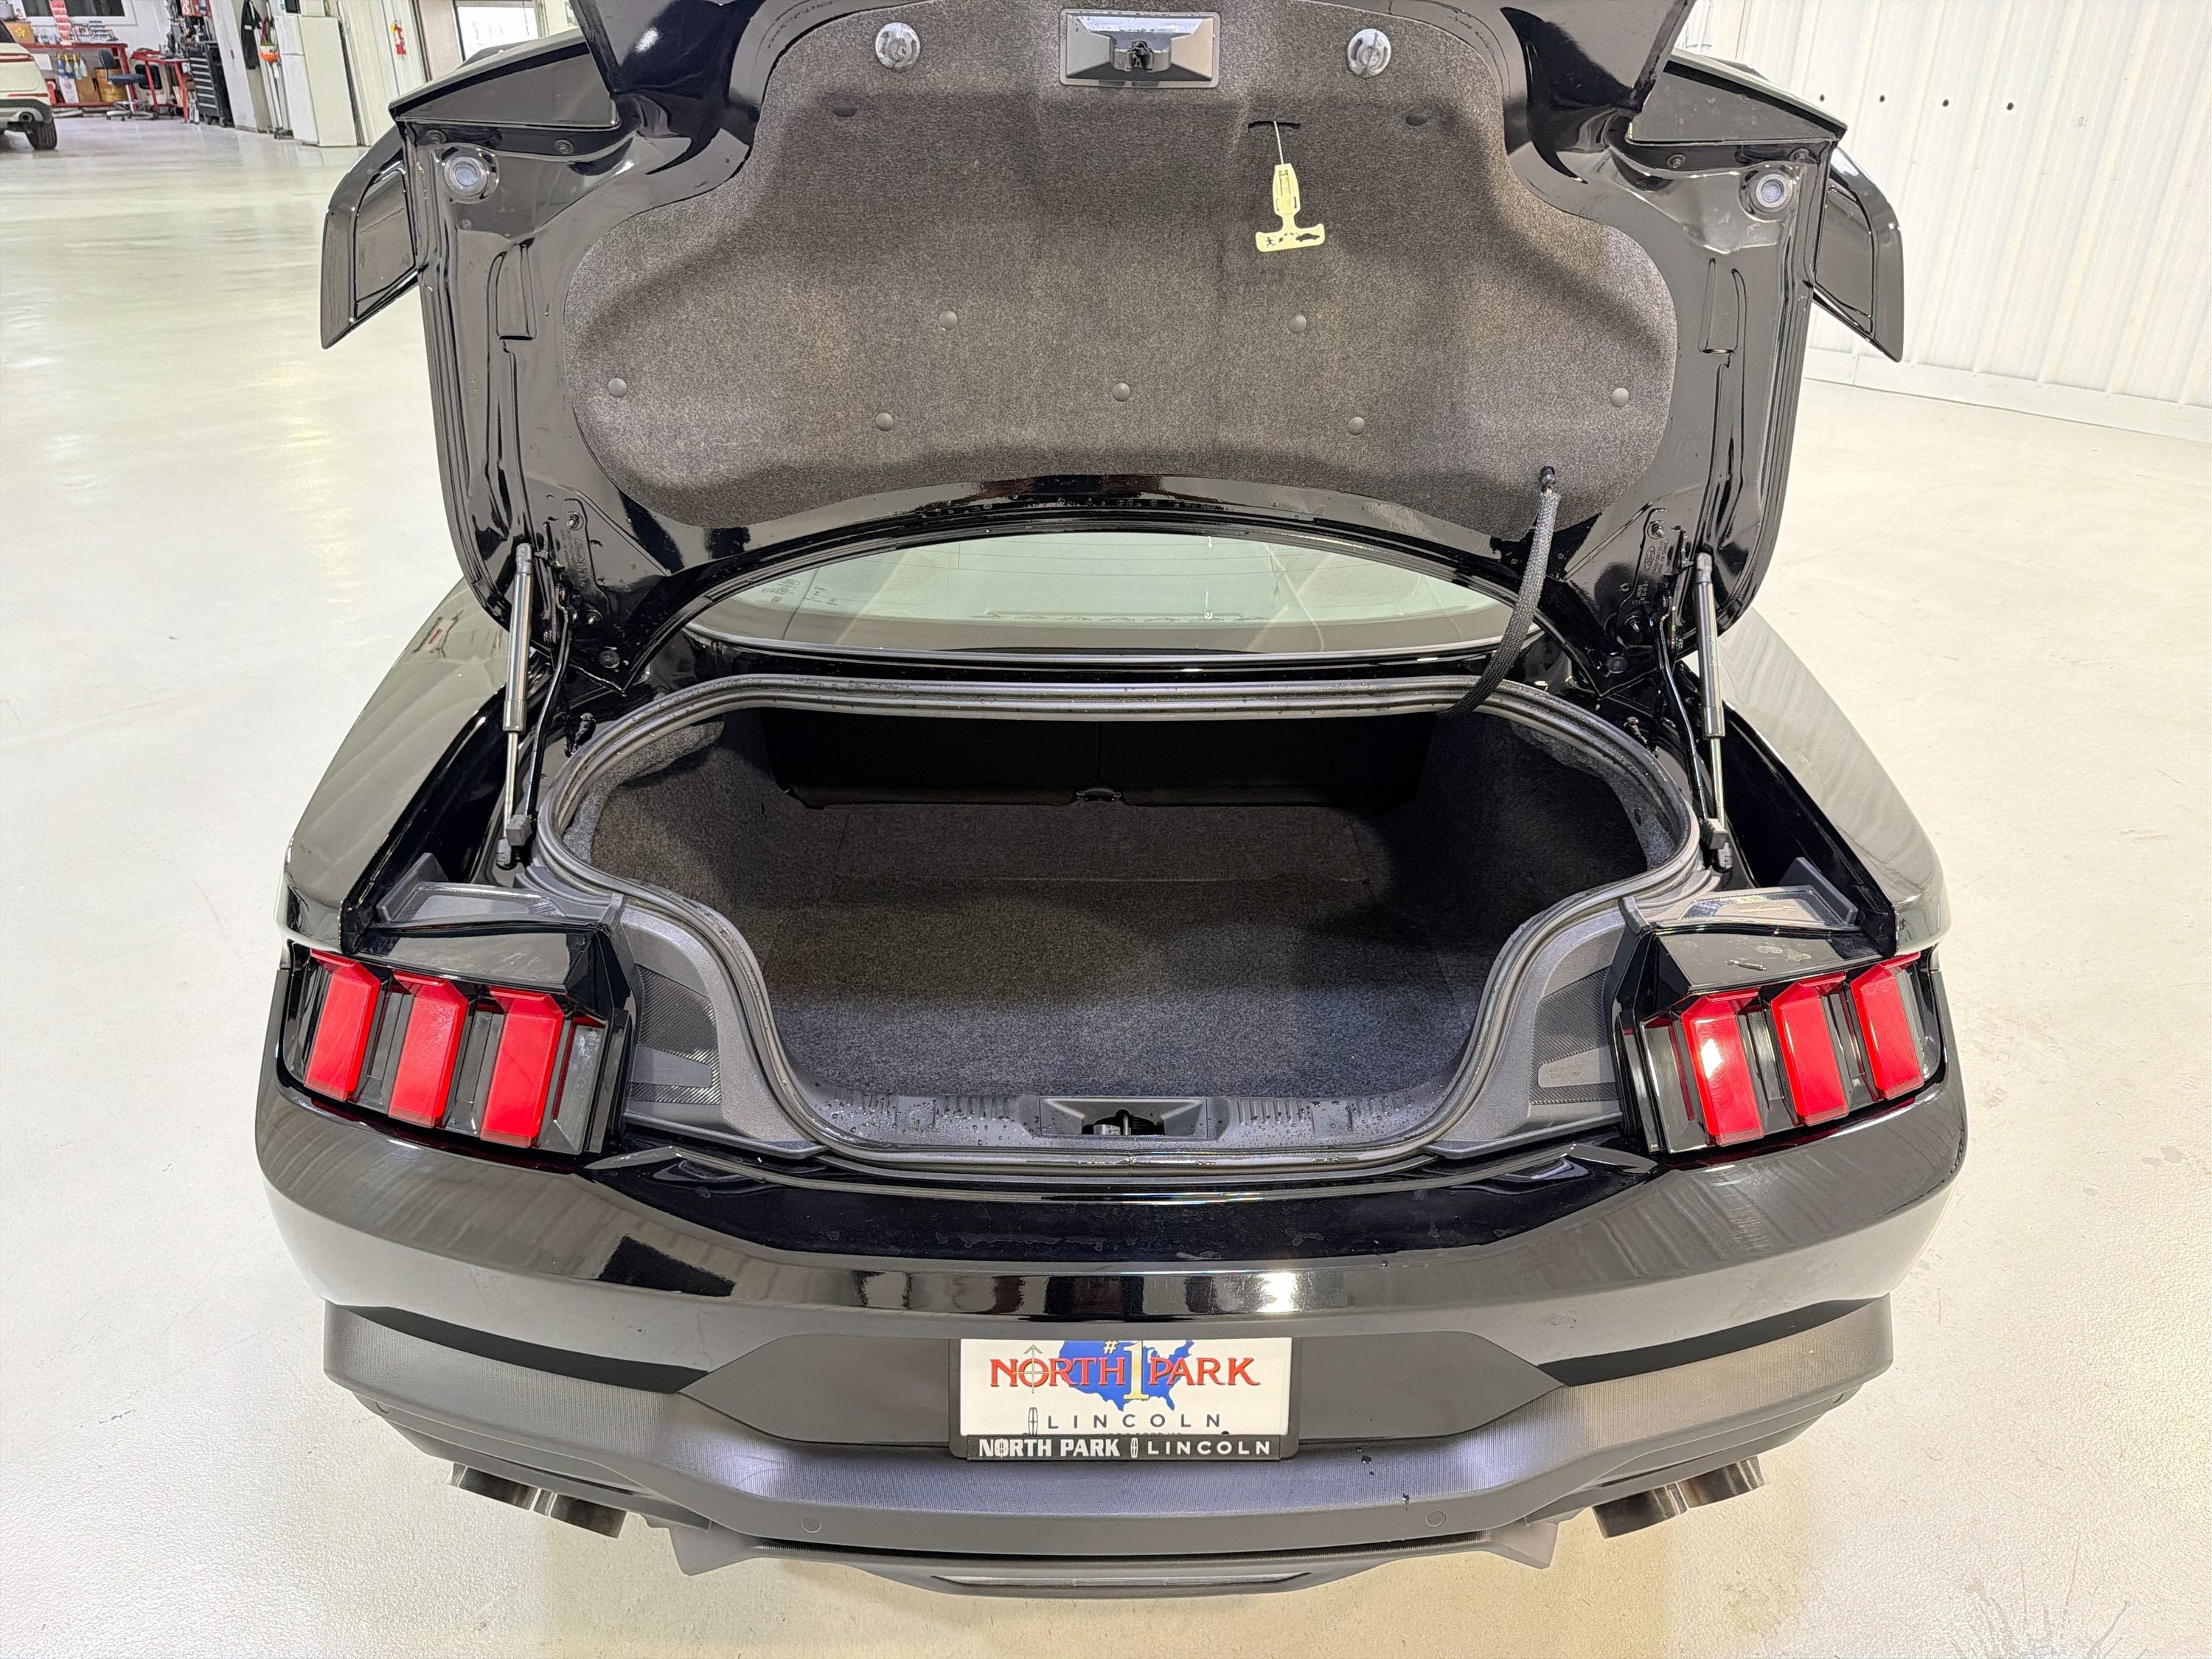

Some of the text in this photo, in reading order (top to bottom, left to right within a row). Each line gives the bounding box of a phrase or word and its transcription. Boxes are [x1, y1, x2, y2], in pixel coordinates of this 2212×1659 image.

[990, 1357, 1262, 1388] NORTH PARK
[1048, 1413, 1220, 1429] LINCOLN
[979, 1439, 1270, 1458] NORTH PARK LINCOLN
